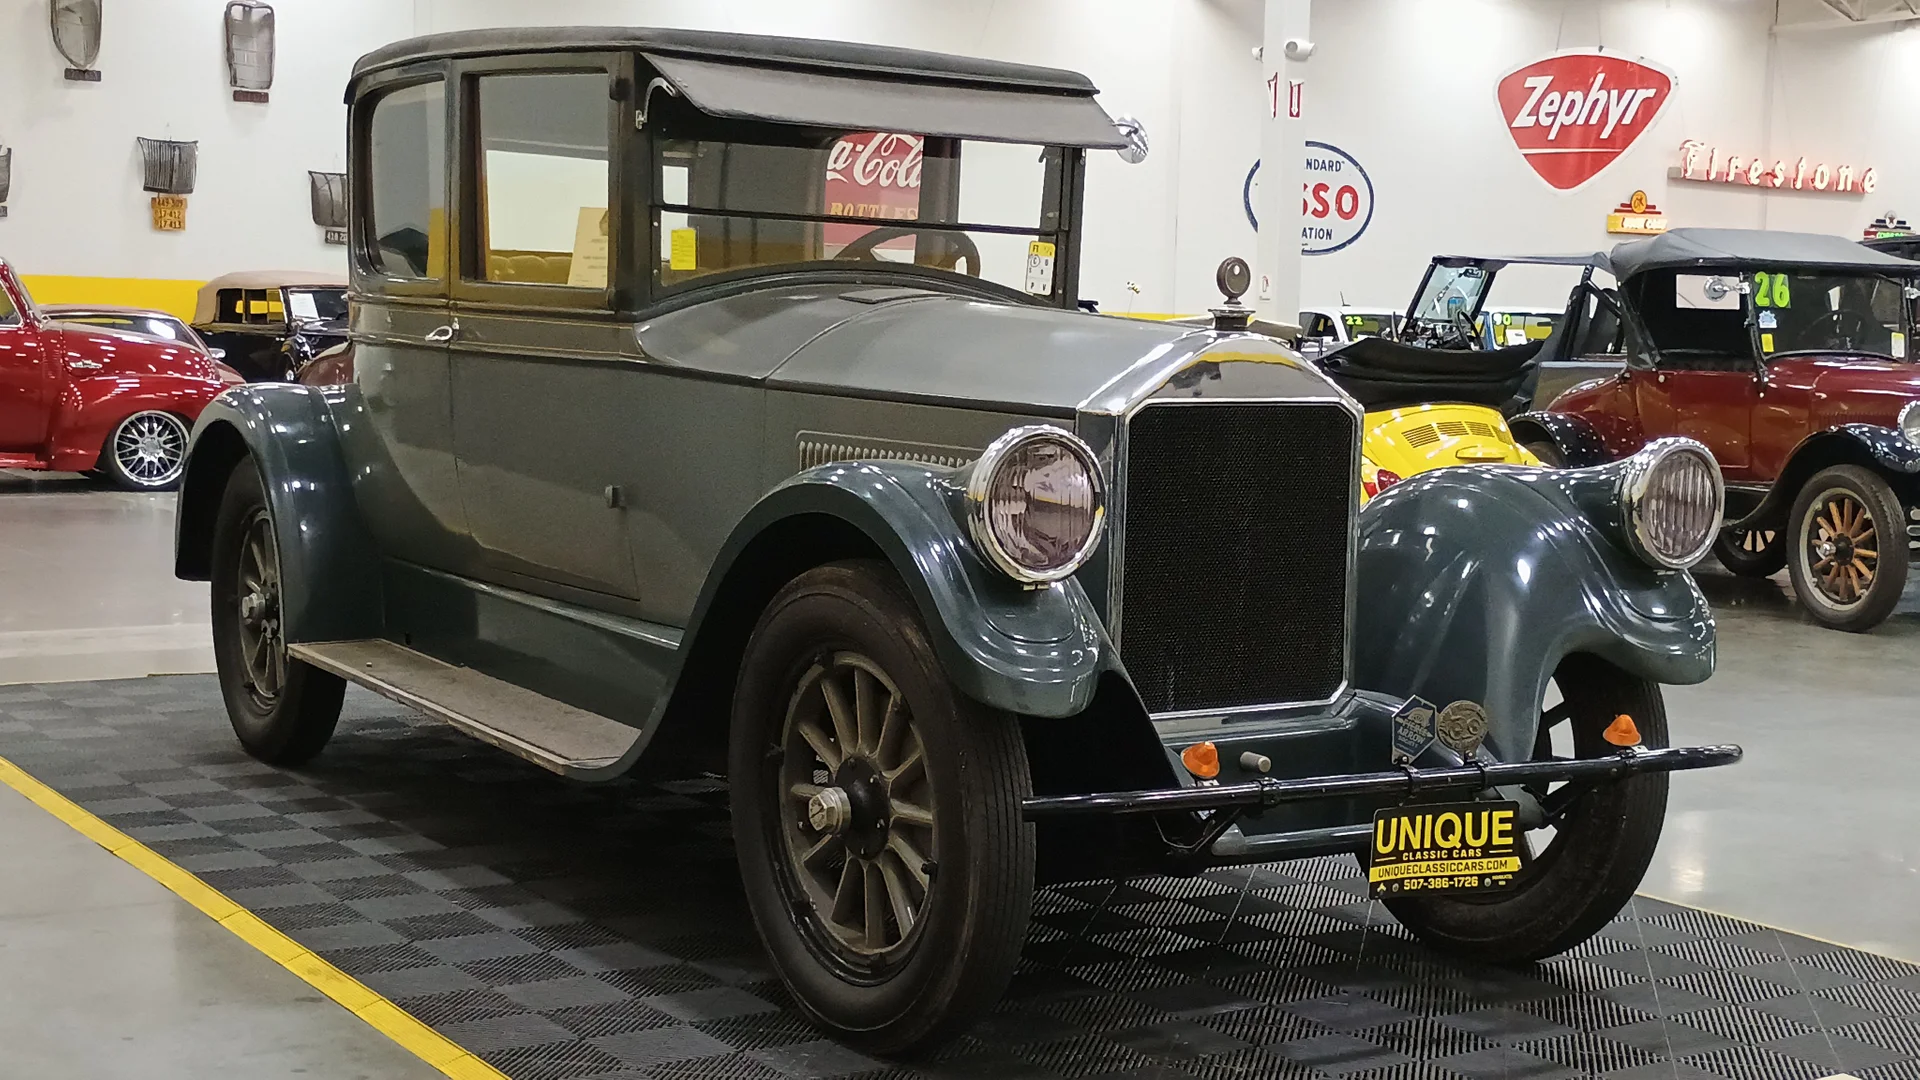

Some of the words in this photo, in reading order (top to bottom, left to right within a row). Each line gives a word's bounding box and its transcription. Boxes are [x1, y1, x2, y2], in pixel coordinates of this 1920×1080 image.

[1511, 73, 1657, 140] Zephyr
[1679, 139, 1878, 194] Firestone
[830, 202, 919, 220] BOTTLES
[1755, 271, 1790, 308] 26
[1345, 315, 1364, 327] 22
[1397, 726, 1426, 745] ARROW
[1376, 810, 1514, 854] UNIQUE
[1402, 850, 1448, 861] CLASSIC
[1452, 848, 1482, 858] CARS
[1378, 859, 1508, 878] UNIQUECLASSICCARS.COM
[1403, 876, 1479, 890] 507-386-1726
